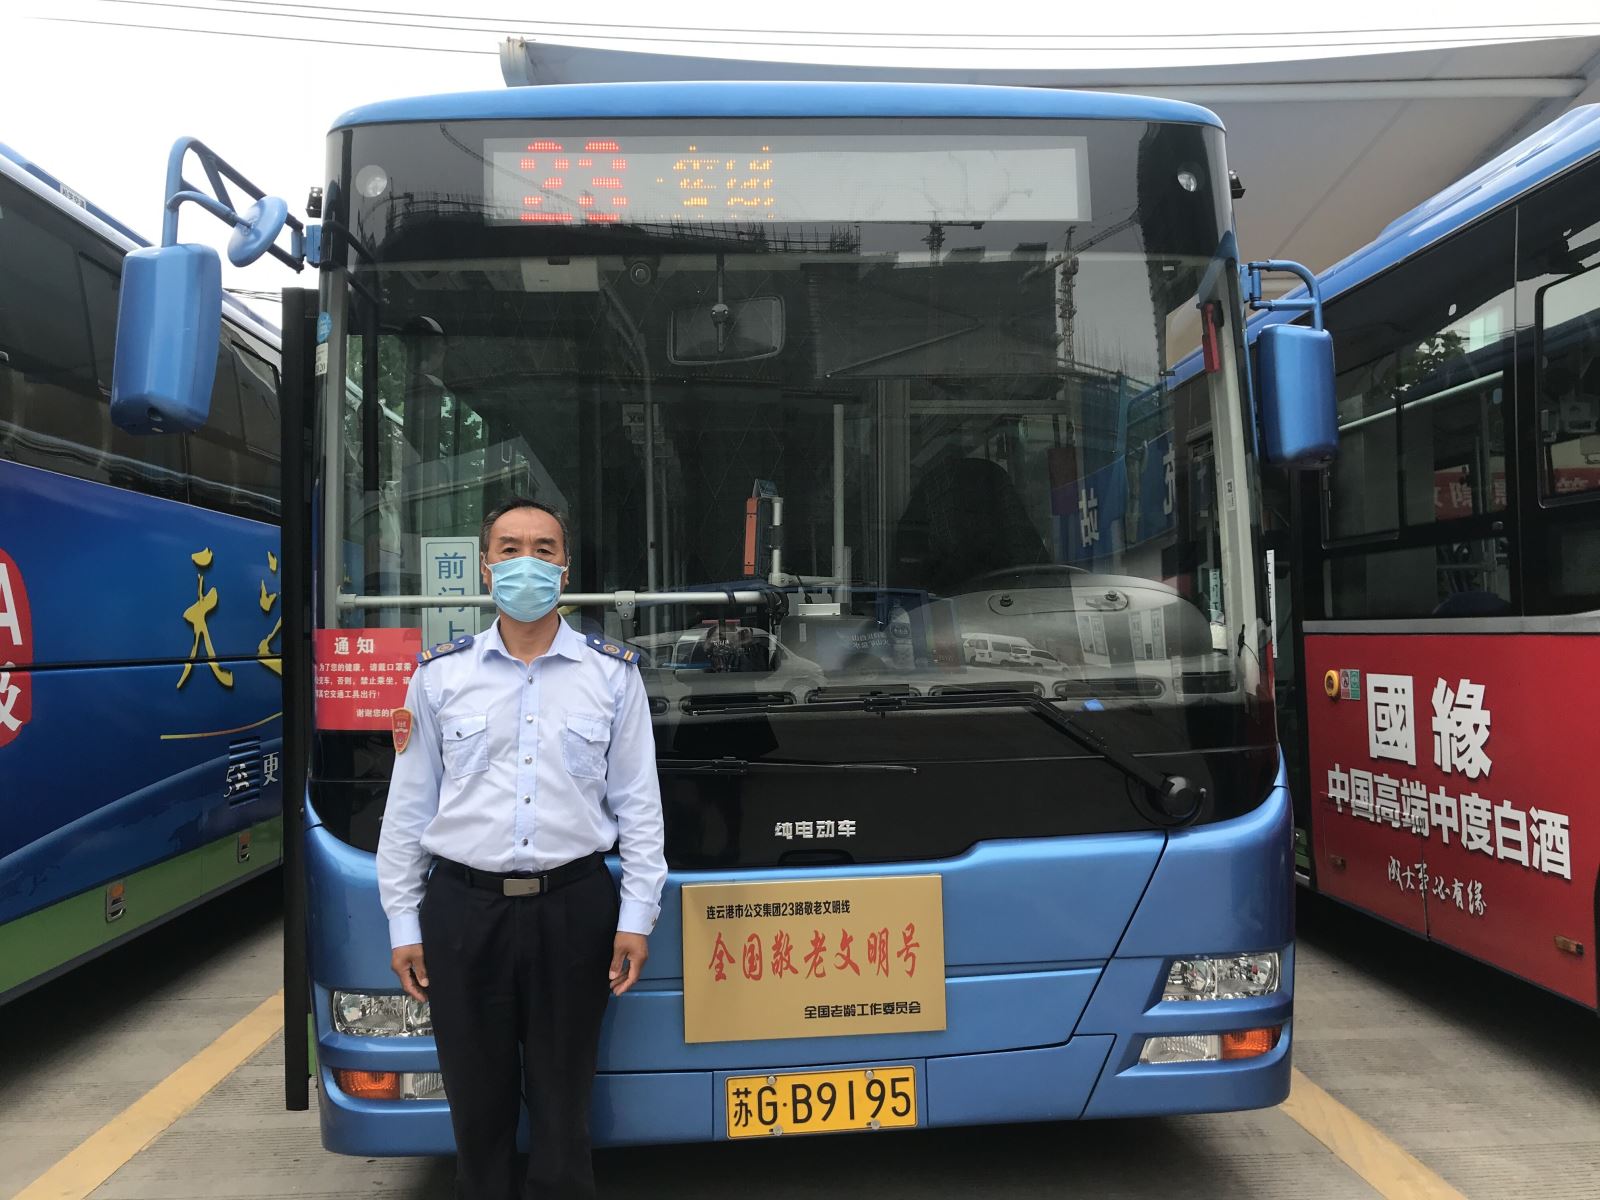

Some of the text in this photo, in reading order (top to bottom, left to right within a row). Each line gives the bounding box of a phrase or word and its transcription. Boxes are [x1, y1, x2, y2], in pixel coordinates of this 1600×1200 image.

[520, 140, 627, 222] 23
[334, 637, 374, 655] 通知
[774, 819, 857, 840] 纯电动车
[1327, 763, 1572, 880] 中国高端中度白酒
[706, 899, 851, 921] 连云港市公交集团23路敬老文明线
[708, 922, 921, 982] 全国敬老文明号
[804, 1001, 921, 1020] 全国老龄工作委员会
[732, 1076, 912, 1128] 苏G·B9195
